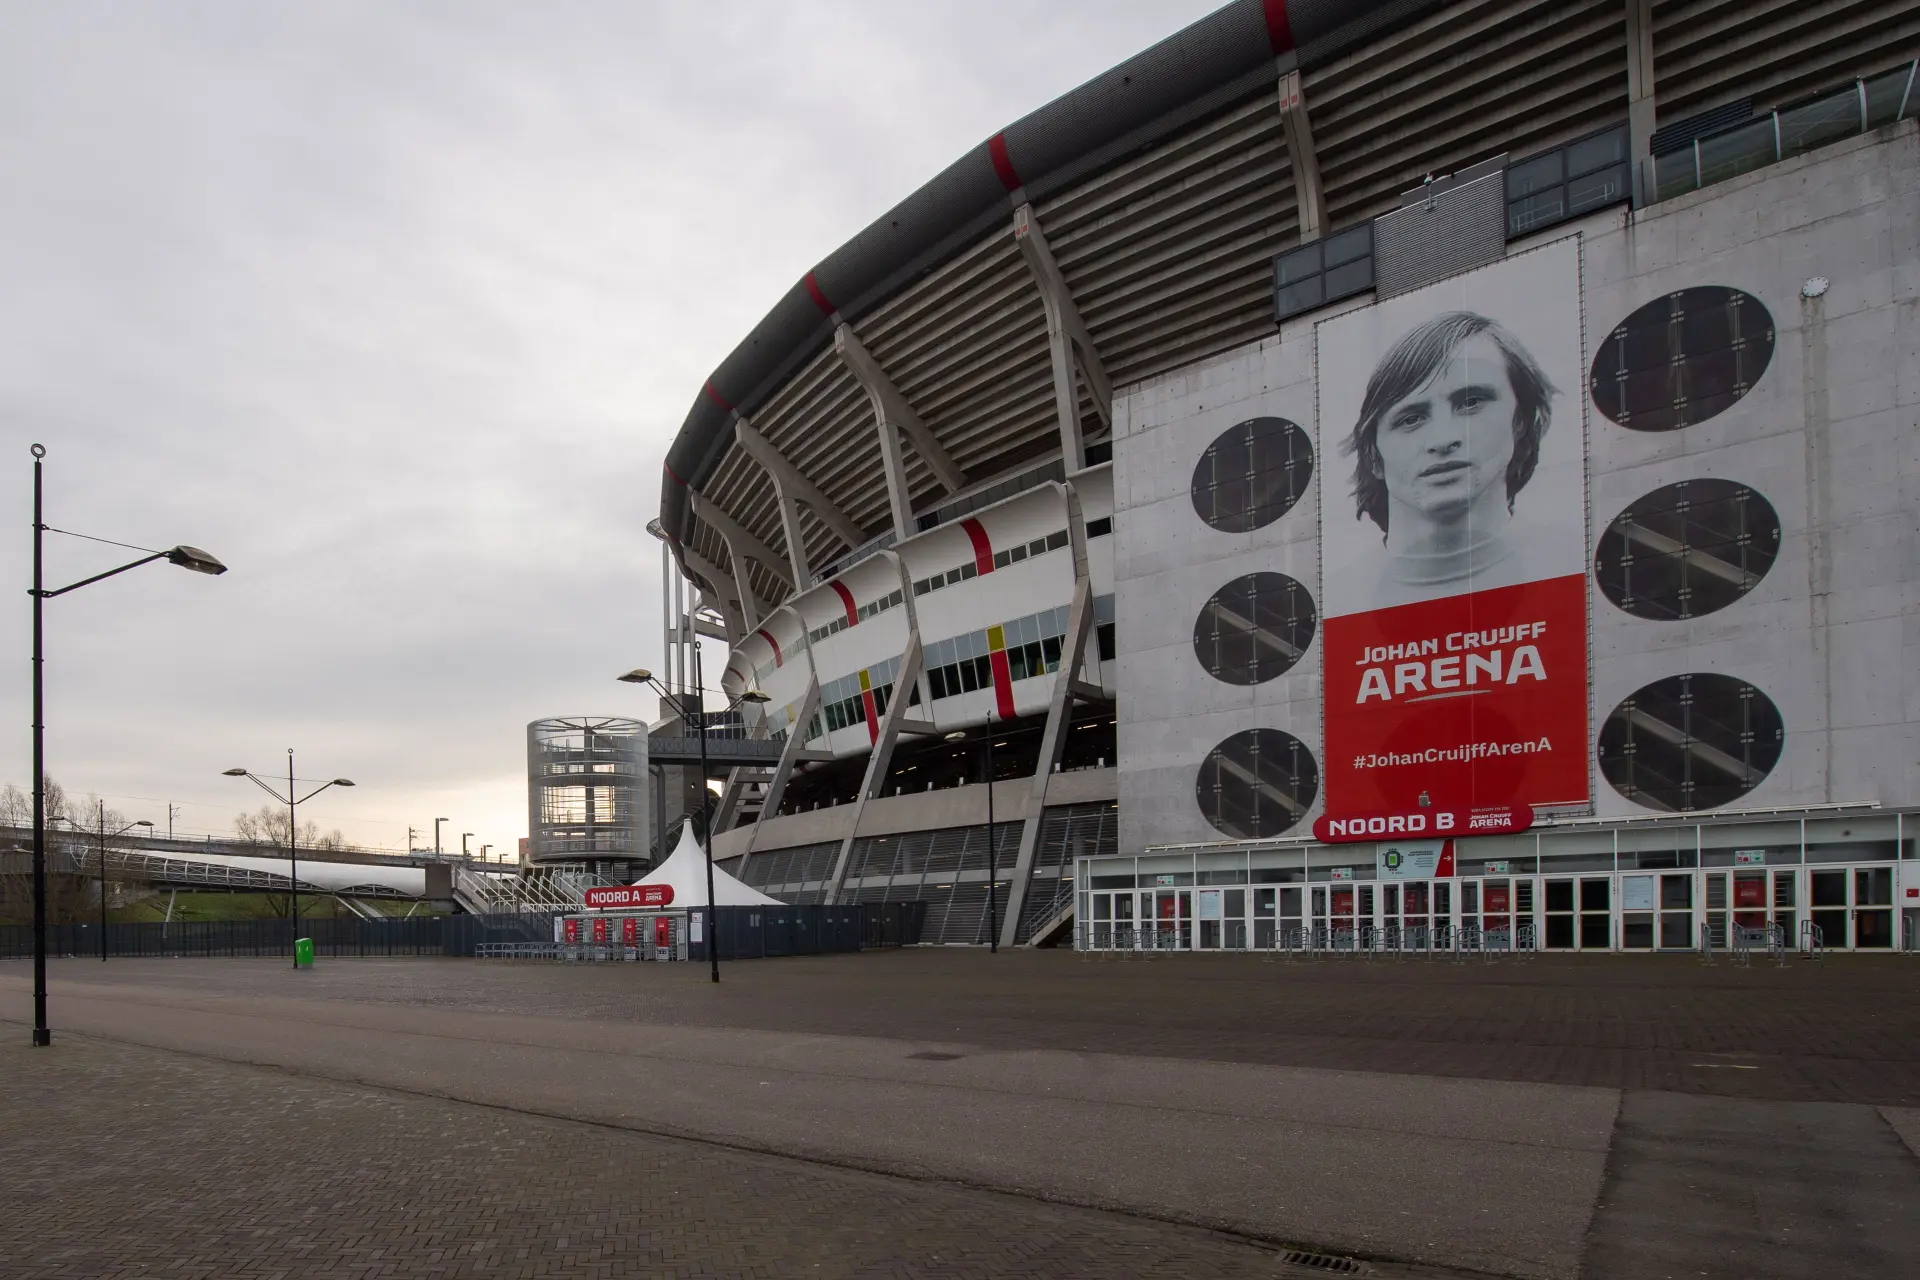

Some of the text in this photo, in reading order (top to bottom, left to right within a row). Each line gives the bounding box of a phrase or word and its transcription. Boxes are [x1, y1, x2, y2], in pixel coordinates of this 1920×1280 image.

[1356, 621, 1546, 665] JOHAN CRUIJFF
[1356, 645, 1547, 704] ARENA
[1353, 737, 1552, 769] #JohanCruijffArenA
[1329, 812, 1455, 836] NOORD B
[1469, 817, 1512, 829] ARENA
[591, 890, 641, 904] NOORD A
